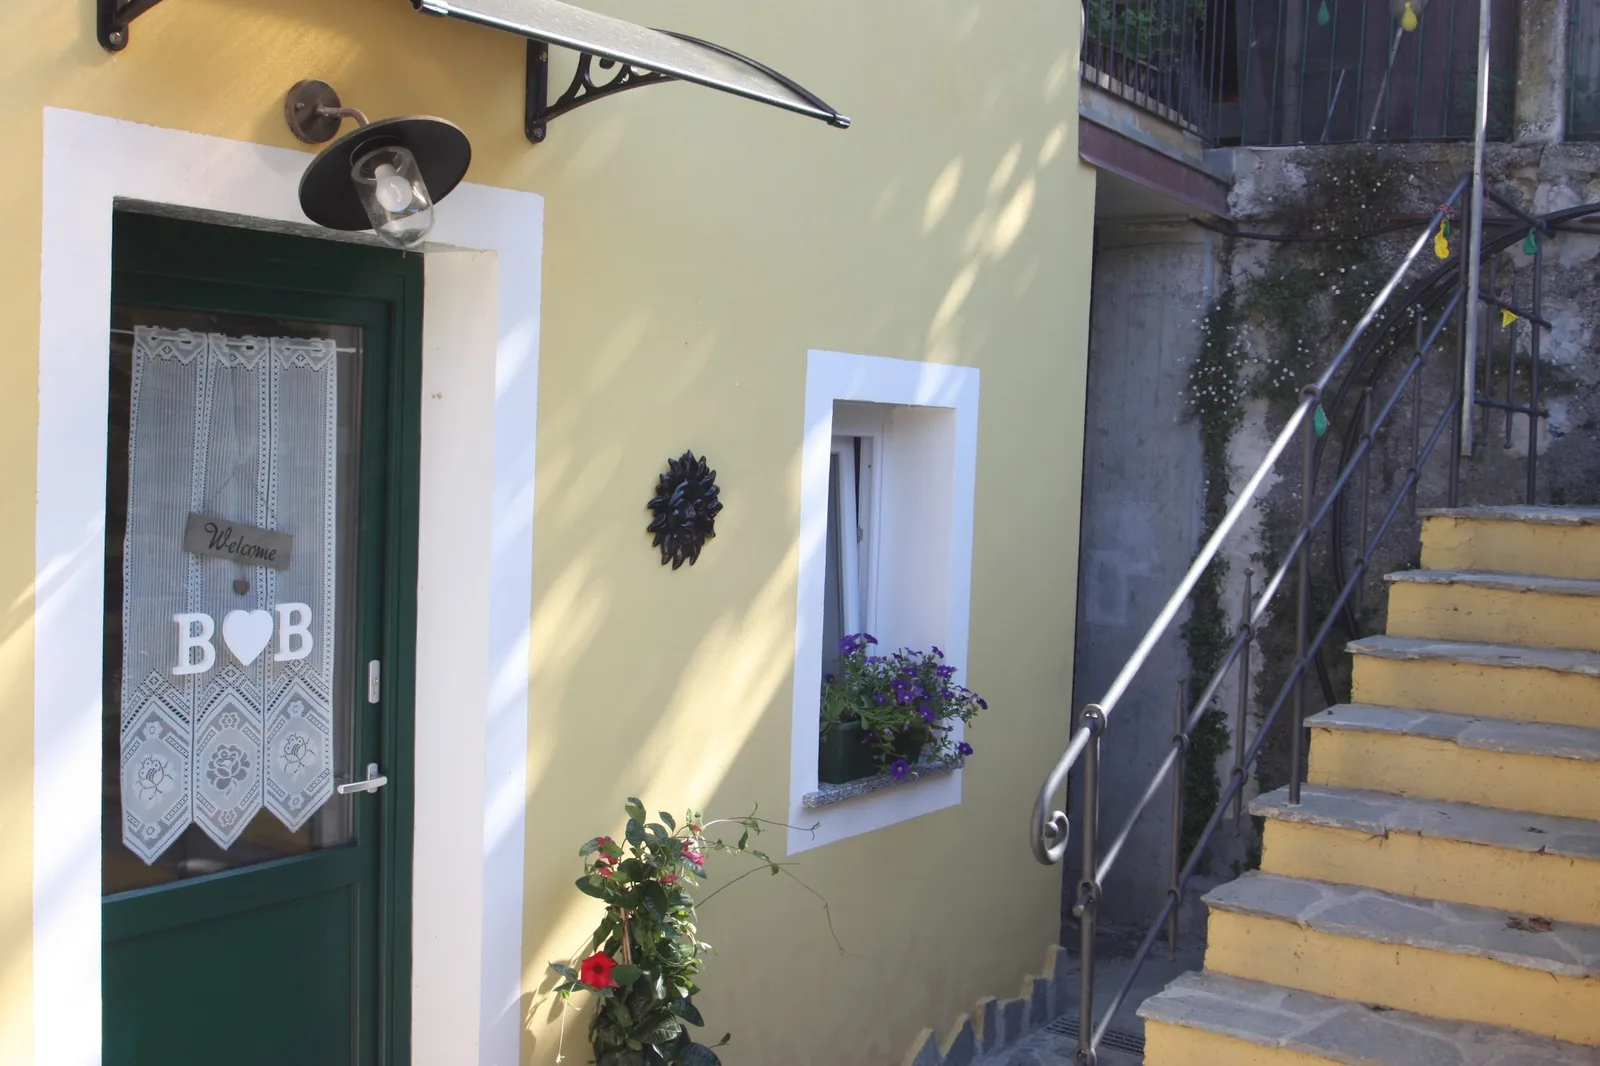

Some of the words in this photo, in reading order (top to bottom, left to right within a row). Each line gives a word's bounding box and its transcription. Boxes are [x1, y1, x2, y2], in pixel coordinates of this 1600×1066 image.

[204, 522, 277, 562] Welcome
[172, 612, 216, 676] B
[273, 602, 314, 662] B
